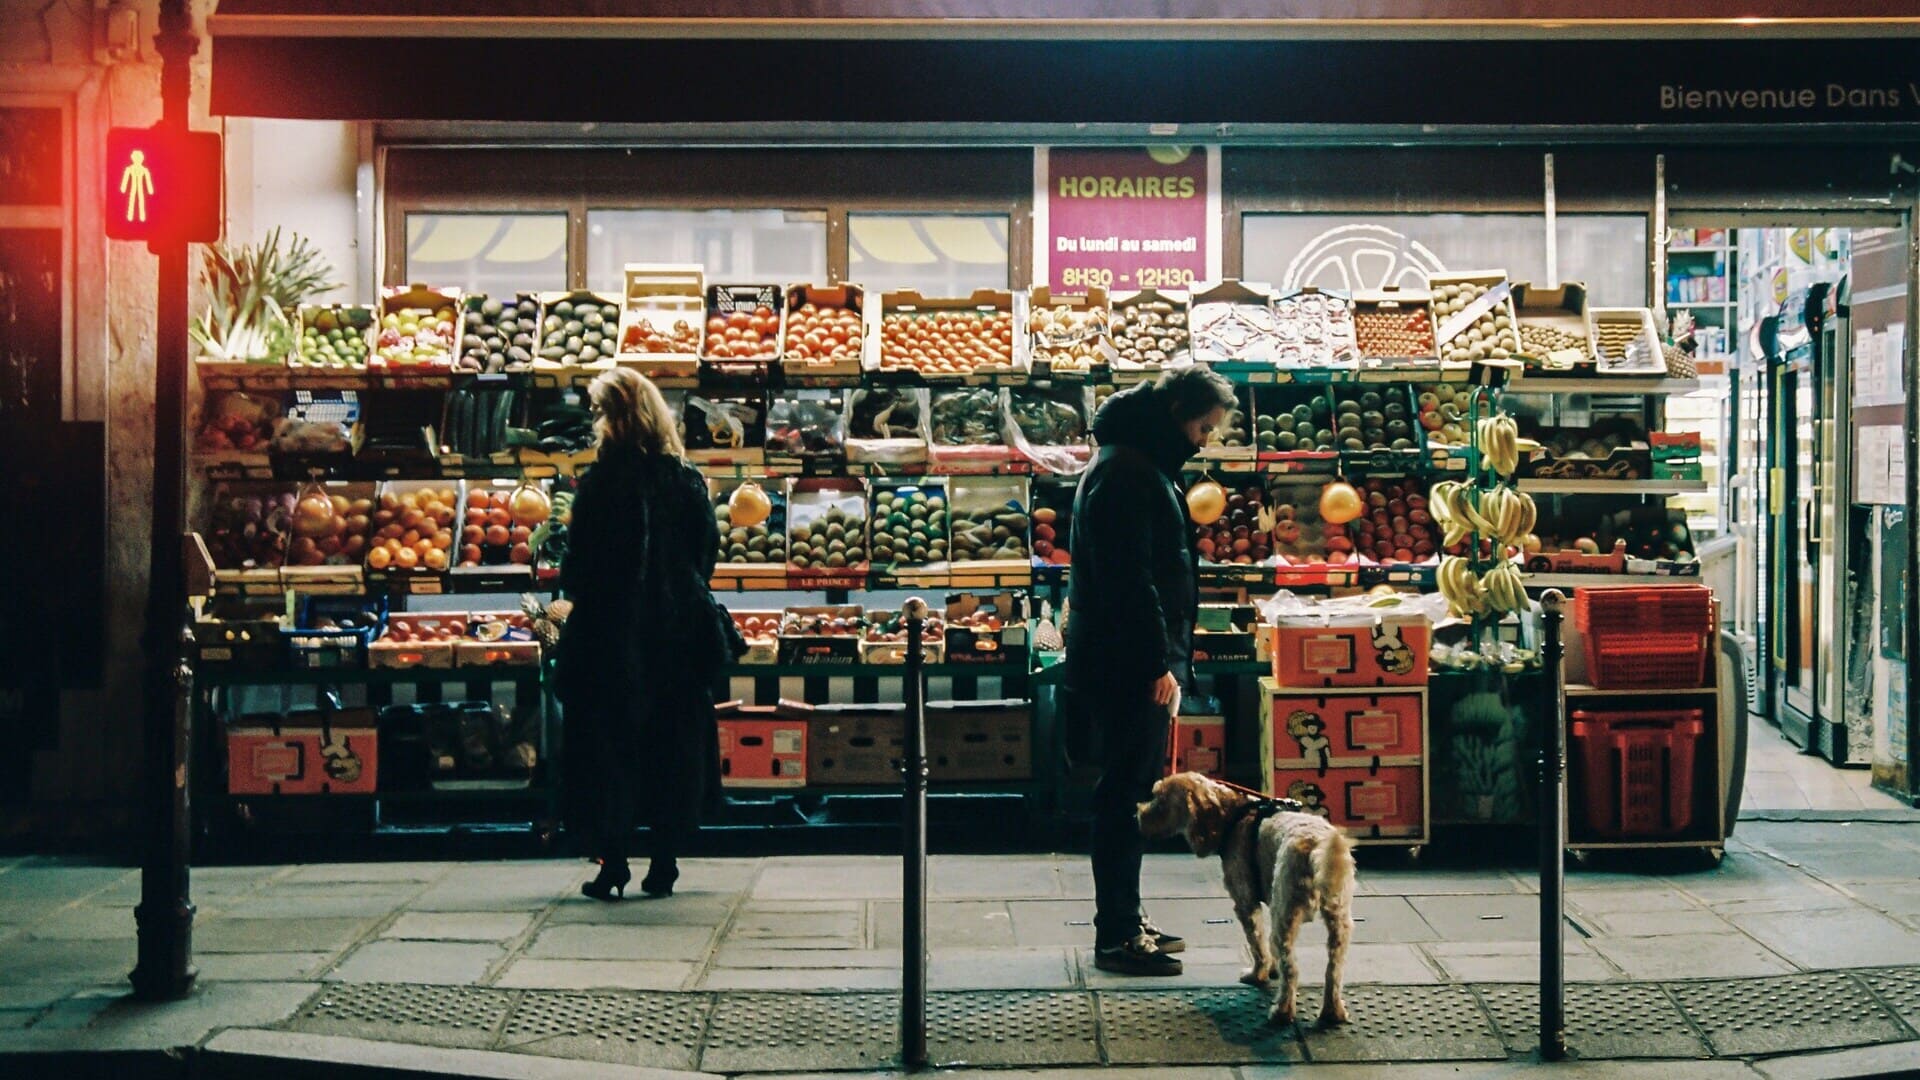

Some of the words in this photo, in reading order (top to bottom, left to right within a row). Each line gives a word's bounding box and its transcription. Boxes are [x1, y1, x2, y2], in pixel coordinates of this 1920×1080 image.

[1659, 85, 1817, 109] Bienvenue
[1826, 83, 1900, 108] Dans
[1060, 175, 1195, 198] HORAIRES
[1056, 236, 1078, 252] Du
[1079, 236, 1119, 252] lundi
[1120, 239, 1140, 252] au
[1142, 236, 1197, 252] samedi
[1062, 267, 1114, 287] 8H30
[1135, 267, 1195, 287] 12H30
[816, 577, 850, 588] PRINCE
